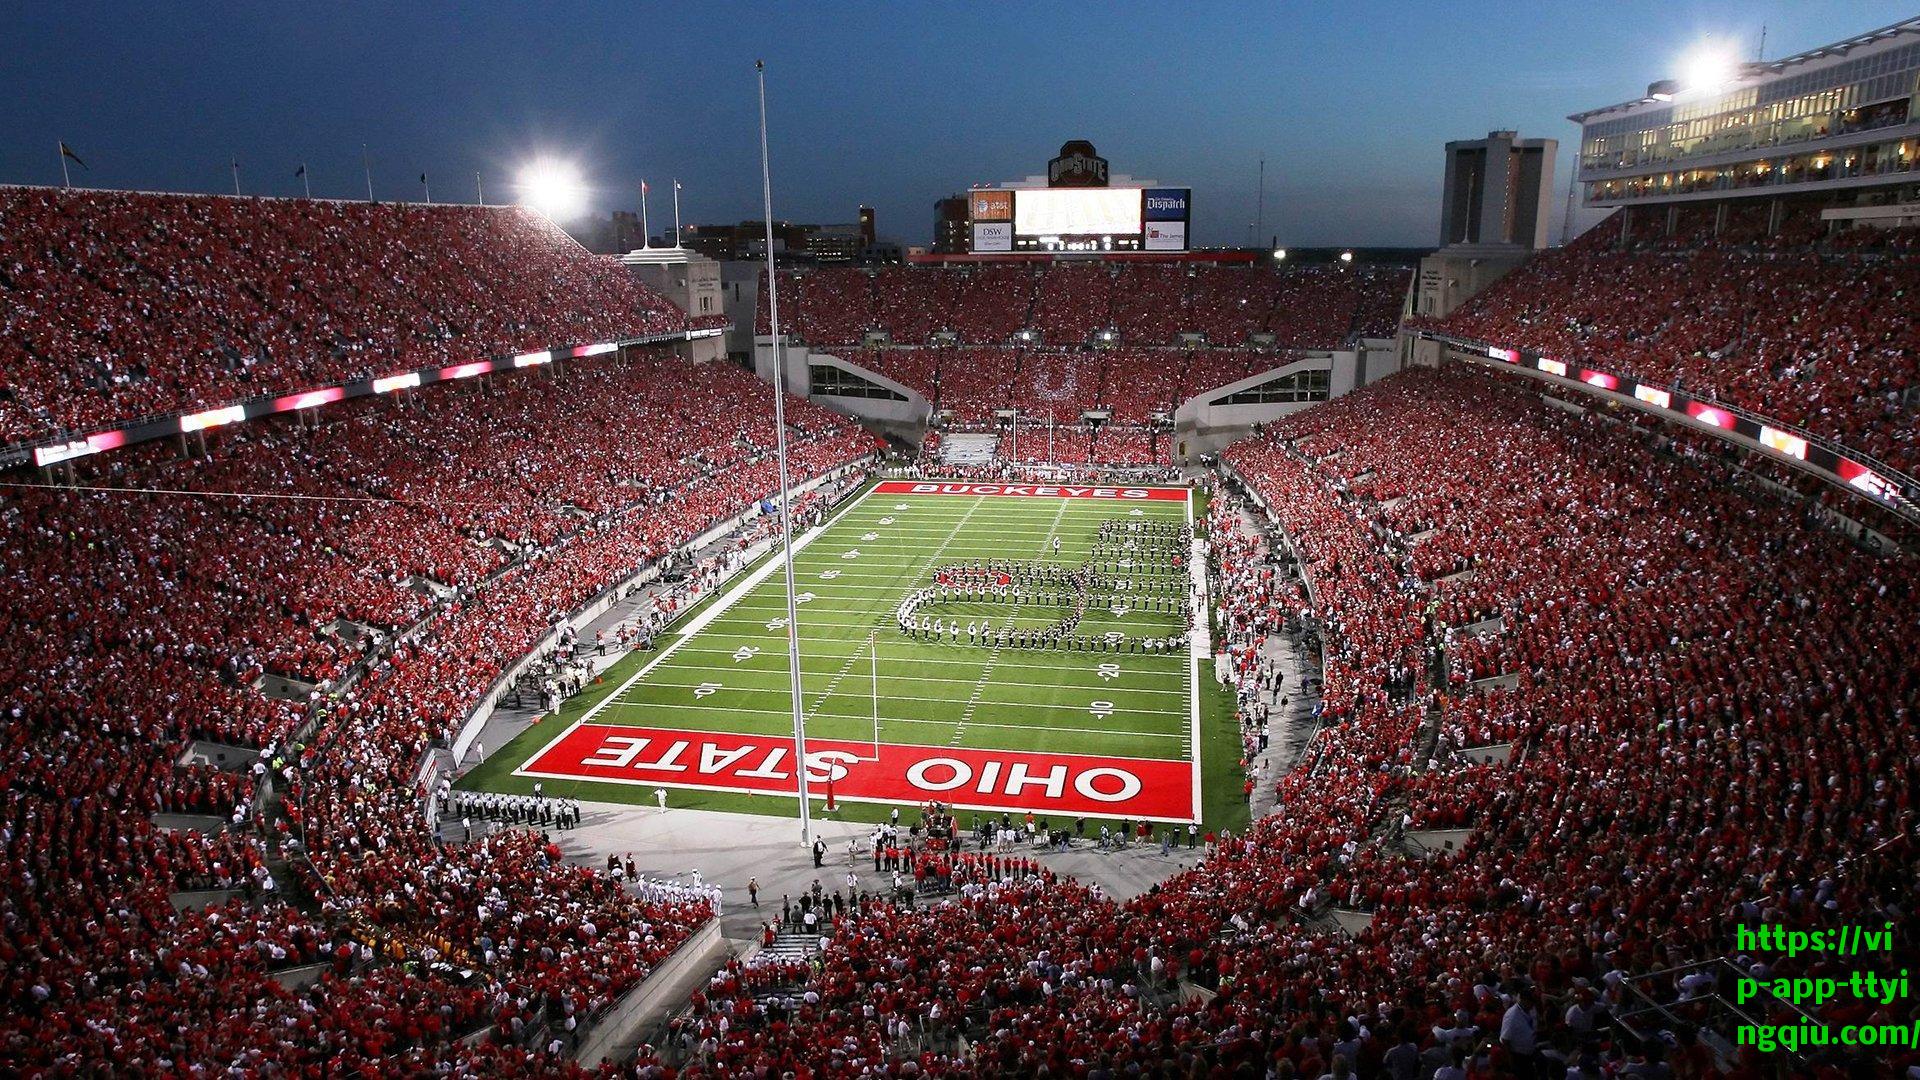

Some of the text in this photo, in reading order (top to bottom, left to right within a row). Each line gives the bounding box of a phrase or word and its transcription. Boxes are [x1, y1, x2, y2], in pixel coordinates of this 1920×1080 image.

[1147, 197, 1185, 210] Dispatch
[911, 484, 1150, 498] BUCKEYES
[733, 646, 760, 659] 20
[1097, 664, 1120, 678] 20
[694, 682, 723, 695] 10
[1089, 701, 1114, 715] 10
[580, 736, 1143, 802] OHIO STATE
